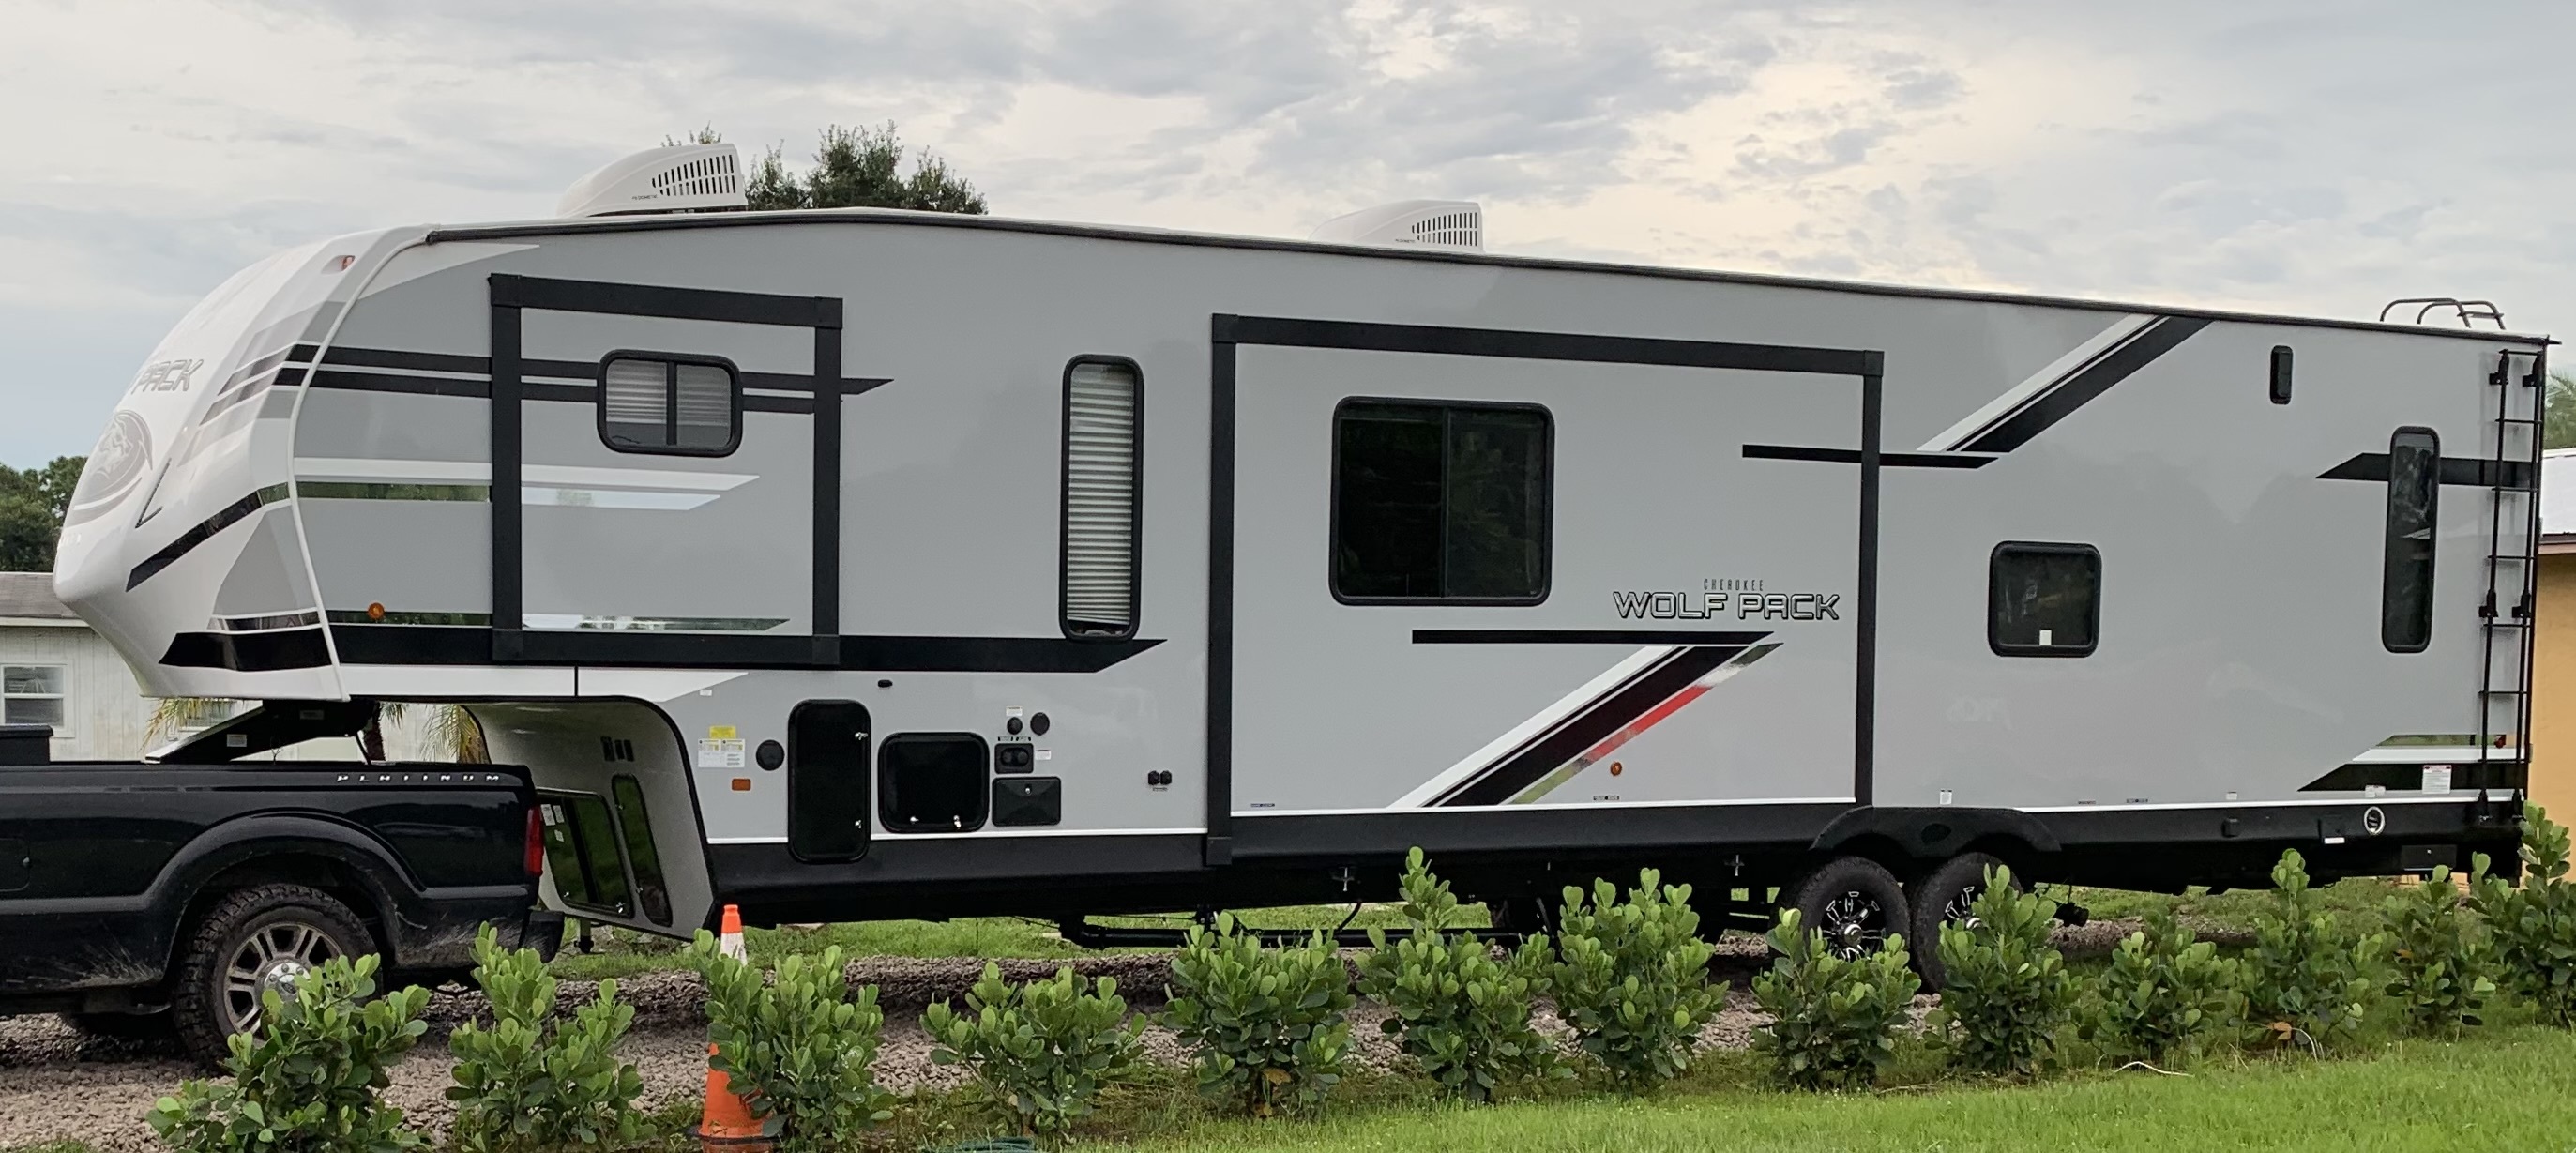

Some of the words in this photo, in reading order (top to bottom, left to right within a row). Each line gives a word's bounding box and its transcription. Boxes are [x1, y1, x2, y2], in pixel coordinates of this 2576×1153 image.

[131, 359, 204, 395] PACK
[1704, 578, 1764, 592] CHEROKEE
[1613, 591, 1728, 619] WOLF
[1738, 593, 1841, 620] PACK
[337, 774, 500, 782] PLATINUM
